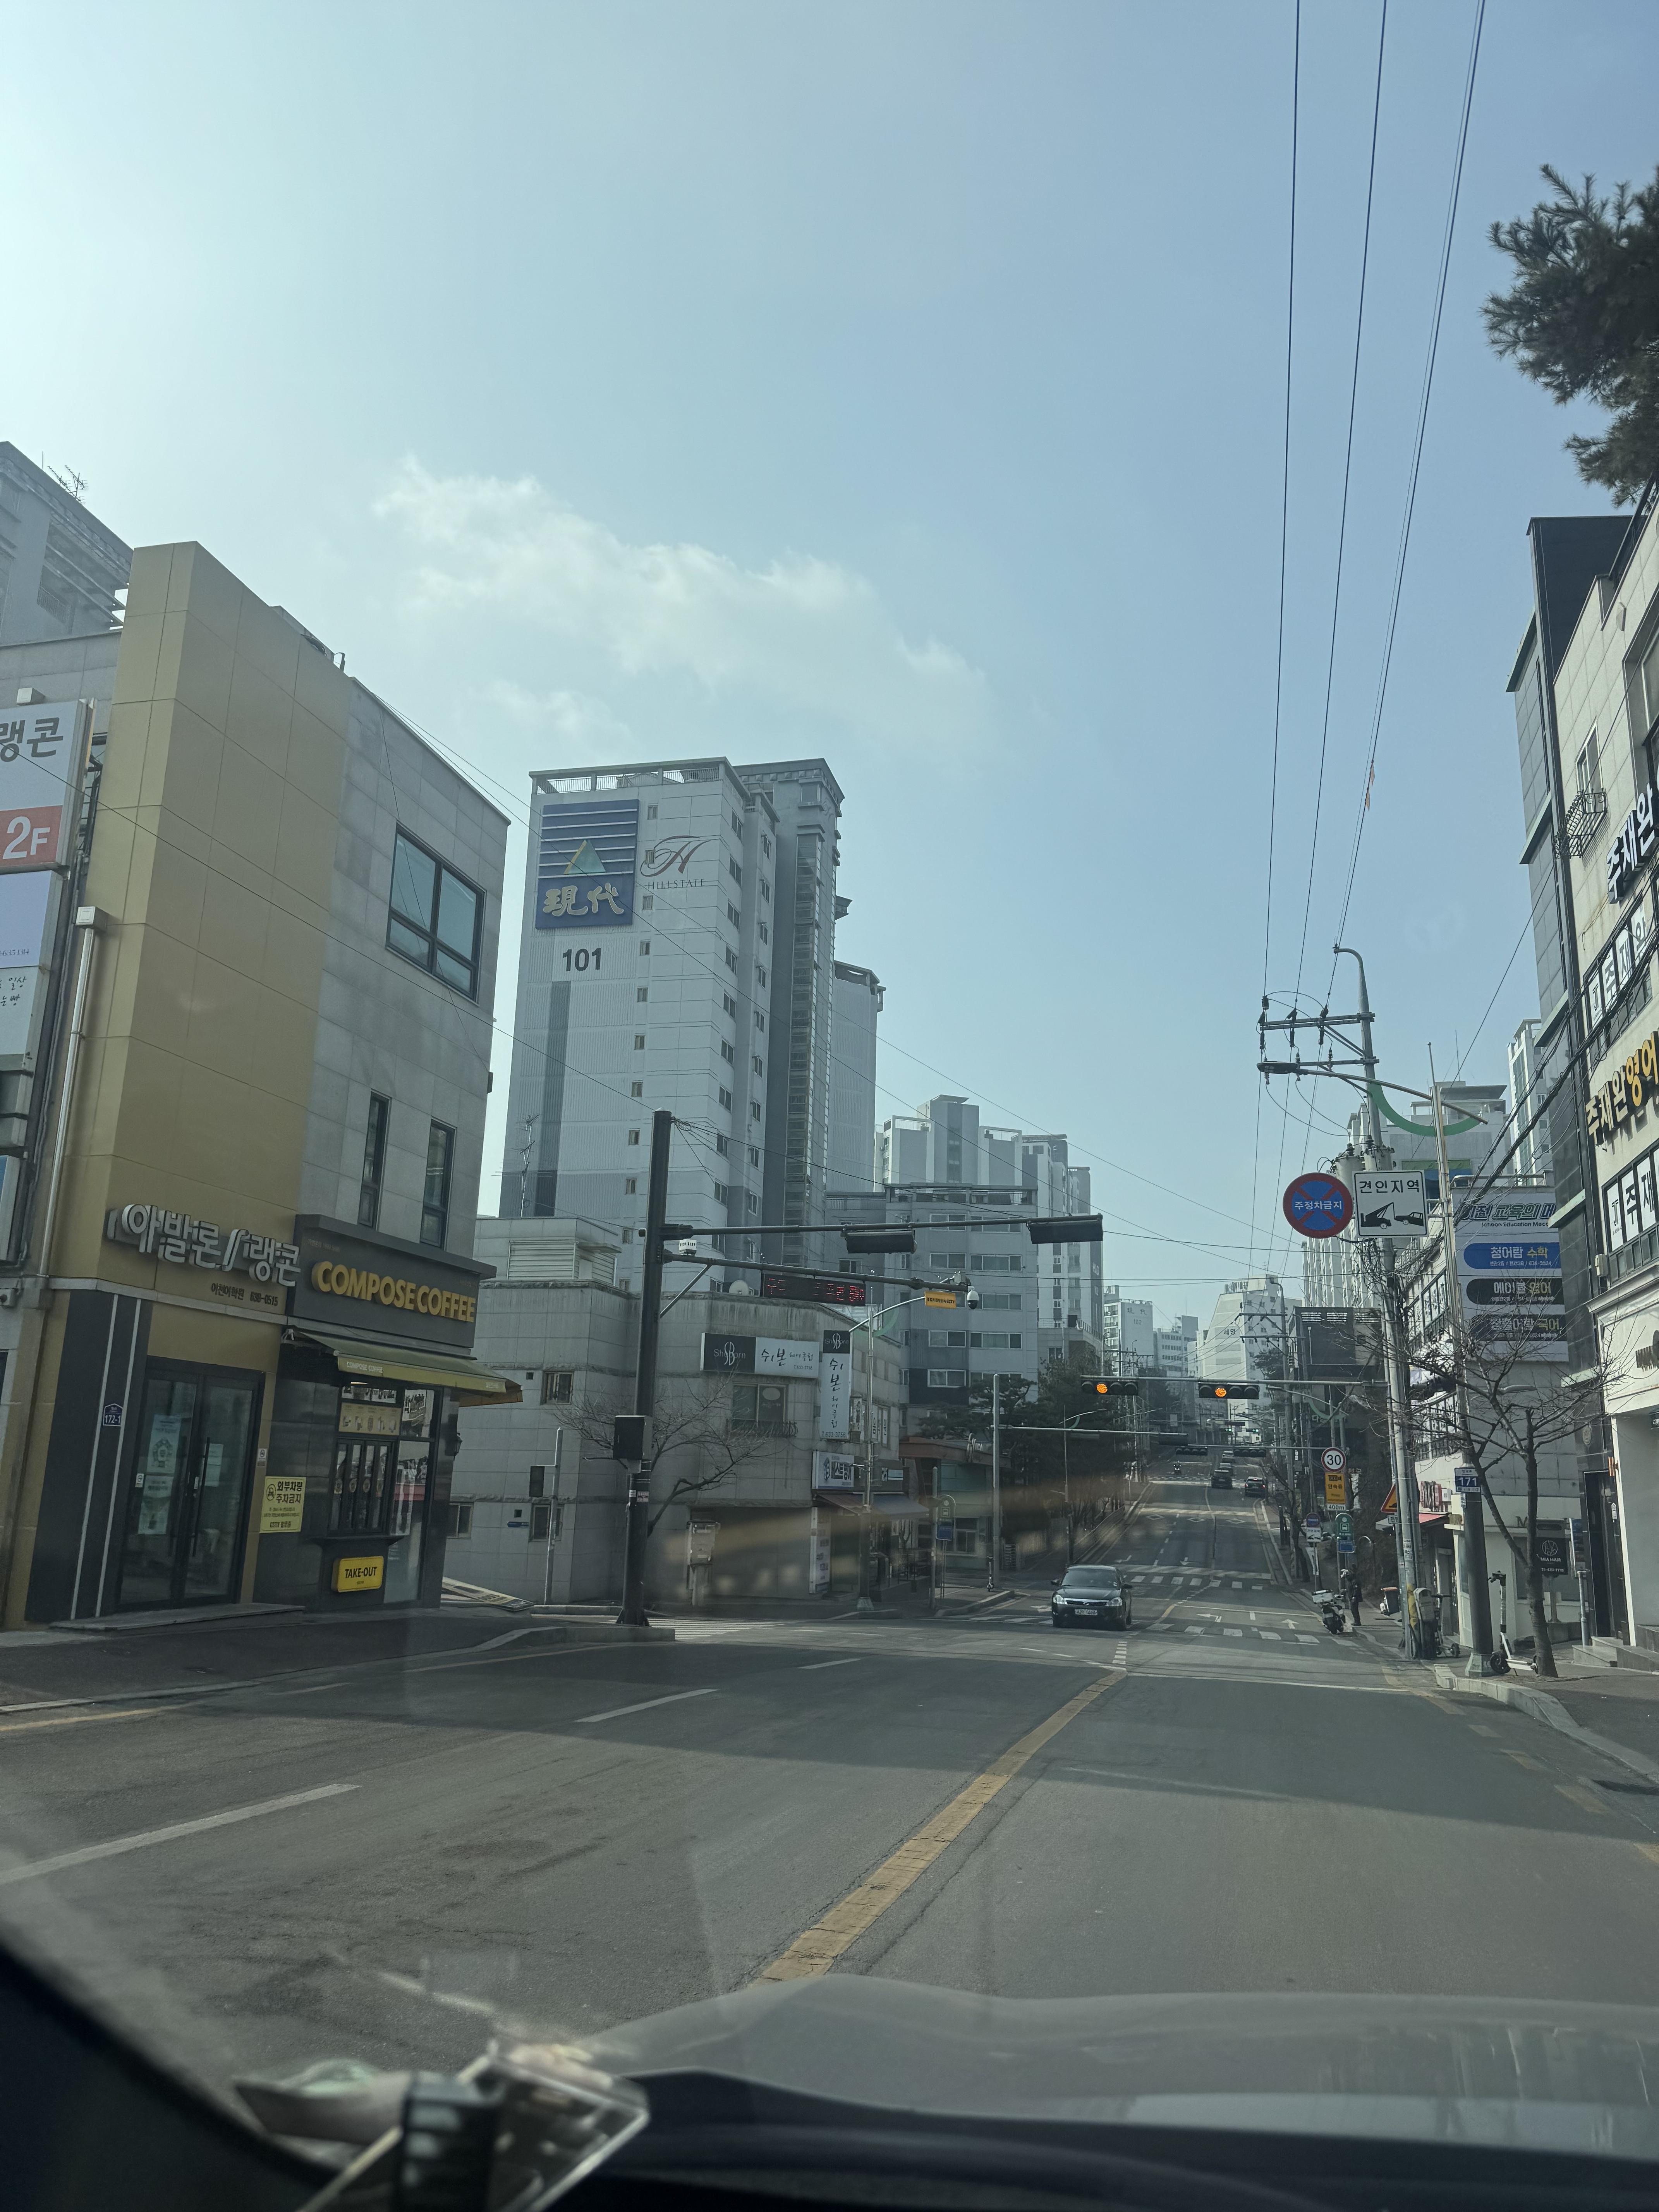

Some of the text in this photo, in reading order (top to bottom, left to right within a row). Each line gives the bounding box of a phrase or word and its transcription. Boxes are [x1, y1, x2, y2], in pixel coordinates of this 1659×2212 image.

[3, 816, 50, 859] 2F
[647, 878, 705, 890] HILLSTATE
[543, 883, 624, 917] 現代
[562, 948, 602, 972] 101
[1359, 1180, 1419, 1193] 견인지역
[1295, 1201, 1342, 1210] 주정차금지
[1491, 1246, 1548, 1259] 청어람 수학
[311, 1261, 476, 1322] COMPOSE COFFEE
[105, 1415, 121, 1424] 172-1
[1327, 1455, 1341, 1465] 30
[277, 1481, 303, 1492] 외부차량
[1459, 1477, 1477, 1486] 171
[276, 1493, 301, 1504] 주차금지
[345, 1566, 378, 1579] TAKE-OUT
